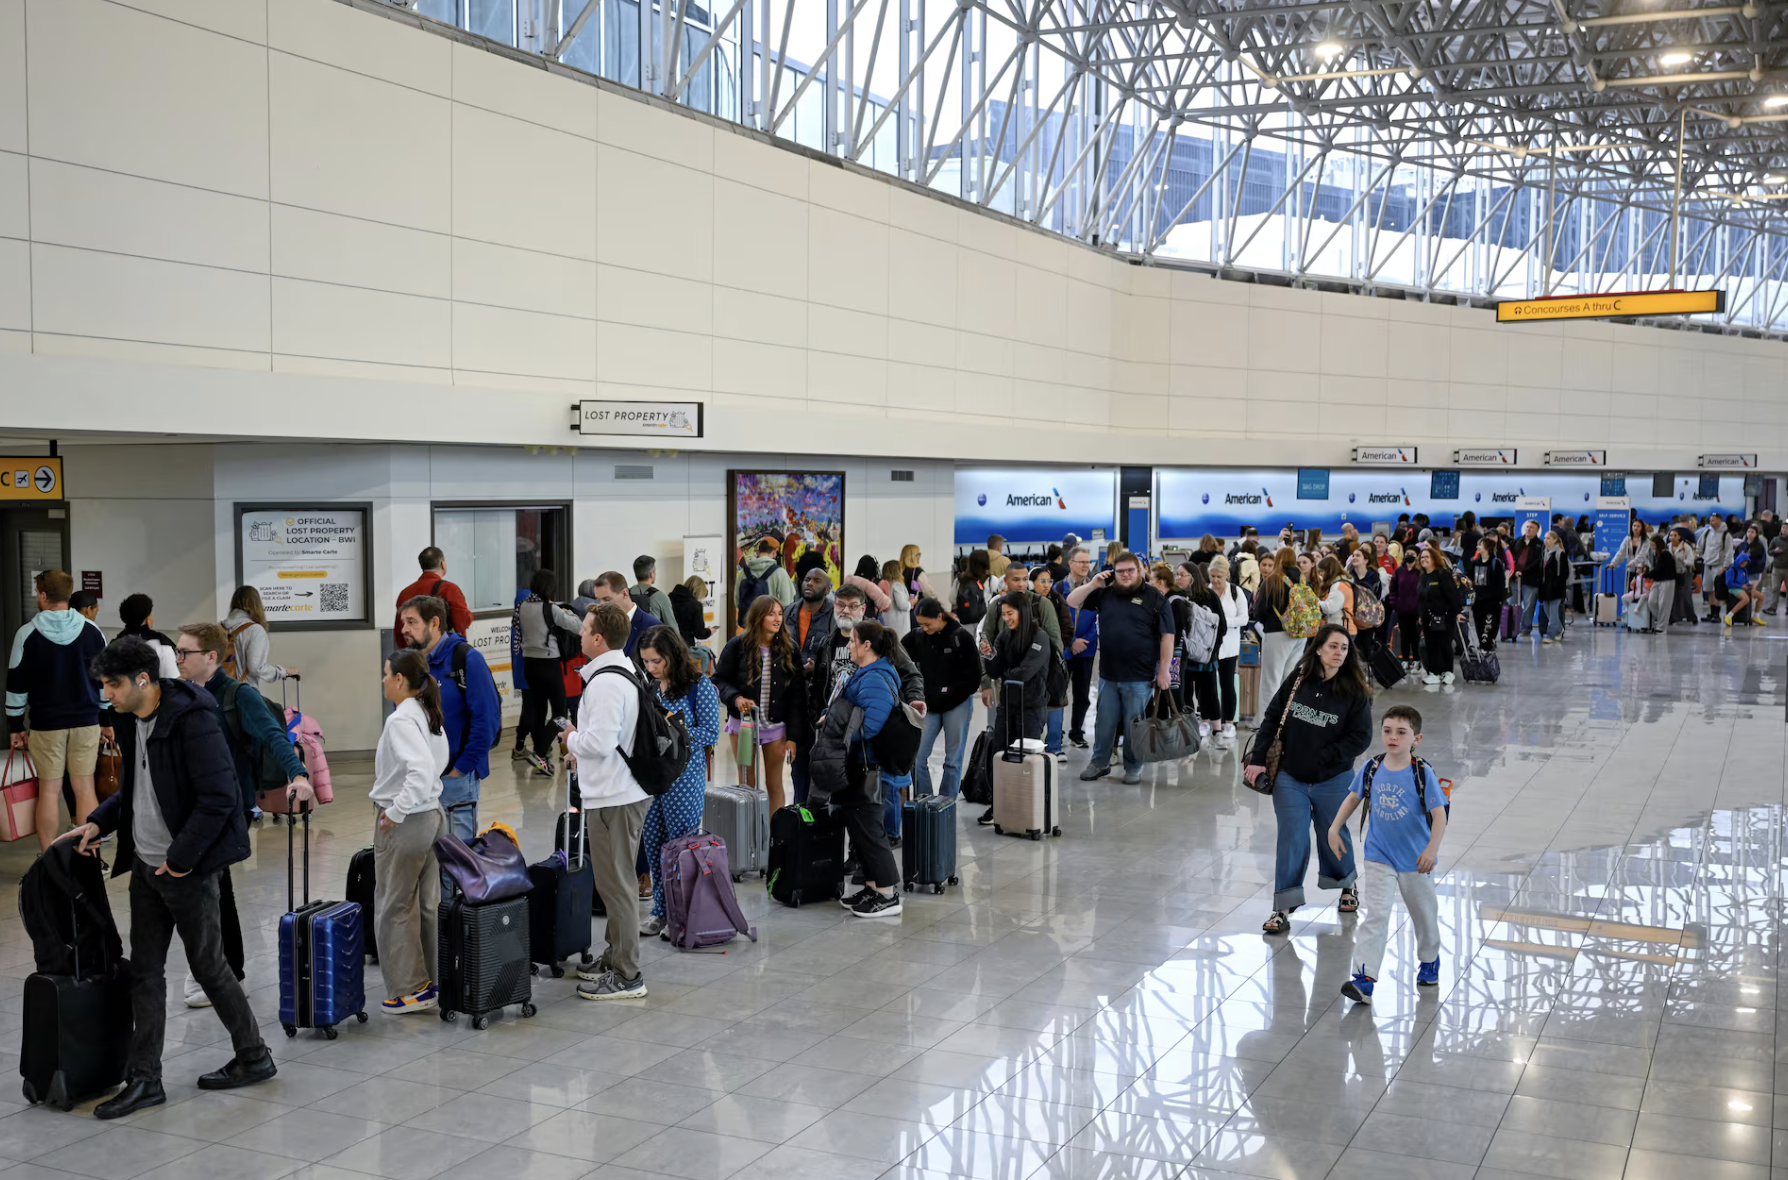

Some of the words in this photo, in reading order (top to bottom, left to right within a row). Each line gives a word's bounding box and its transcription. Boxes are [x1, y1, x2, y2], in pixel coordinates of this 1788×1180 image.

[1523, 304, 1580, 315] Concourses
[1583, 303, 1591, 312] A
[1592, 302, 1612, 311] thru
[1613, 300, 1621, 311] C
[584, 411, 610, 420] LOST
[614, 411, 669, 421] PROPERTY
[1361, 451, 1397, 460] American
[1463, 454, 1497, 462] American
[1554, 455, 1587, 463] American
[0, 471, 10, 487] C
[1006, 493, 1052, 507] American
[1224, 492, 1262, 505] American
[1368, 492, 1401, 504] American
[473, 637, 492, 648] LOST
[1375, 782, 1406, 798] NORTH
[1374, 802, 1411, 821] CAROLINA
